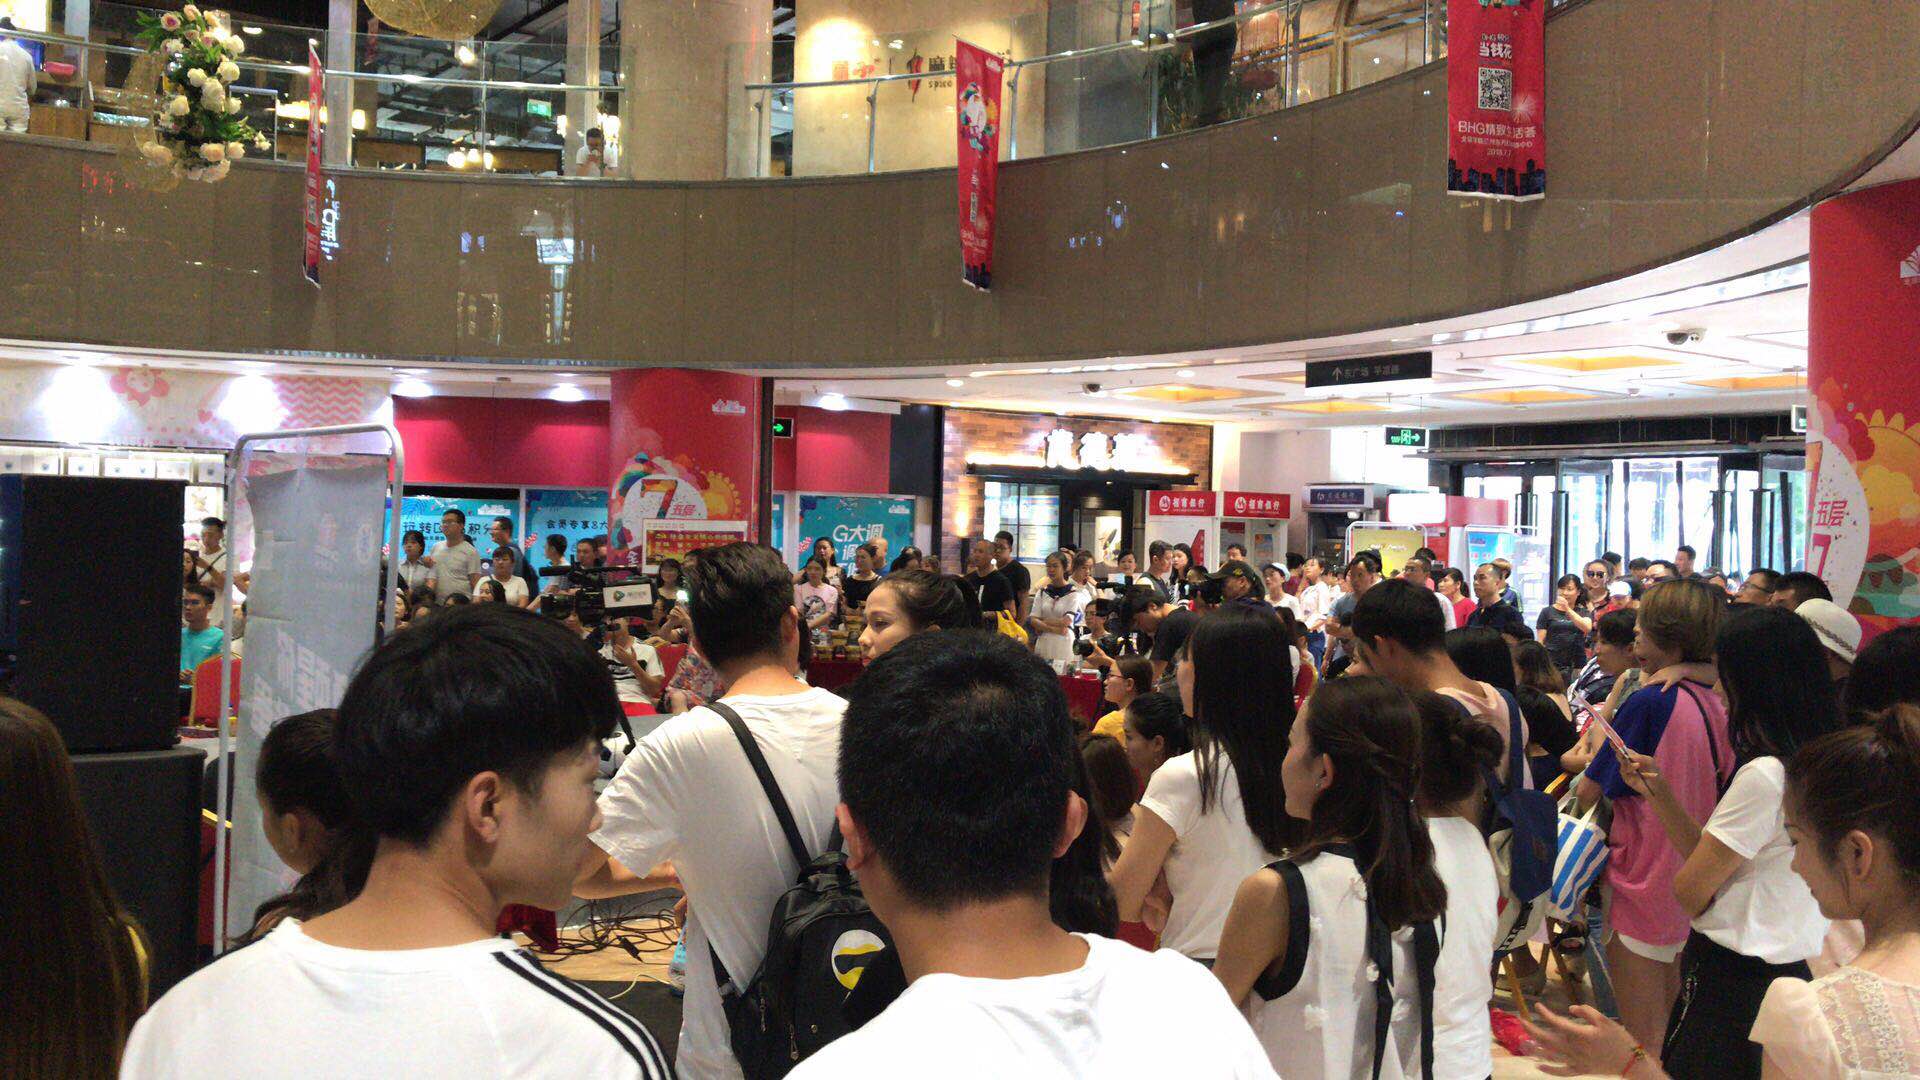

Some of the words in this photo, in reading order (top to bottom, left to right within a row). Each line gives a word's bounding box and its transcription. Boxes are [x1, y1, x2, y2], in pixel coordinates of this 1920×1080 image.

[1172, 496, 1205, 509] 招商银行
[1248, 498, 1281, 512] 招商银行
[1816, 500, 1848, 527] 五层
[832, 523, 884, 543] G大调
